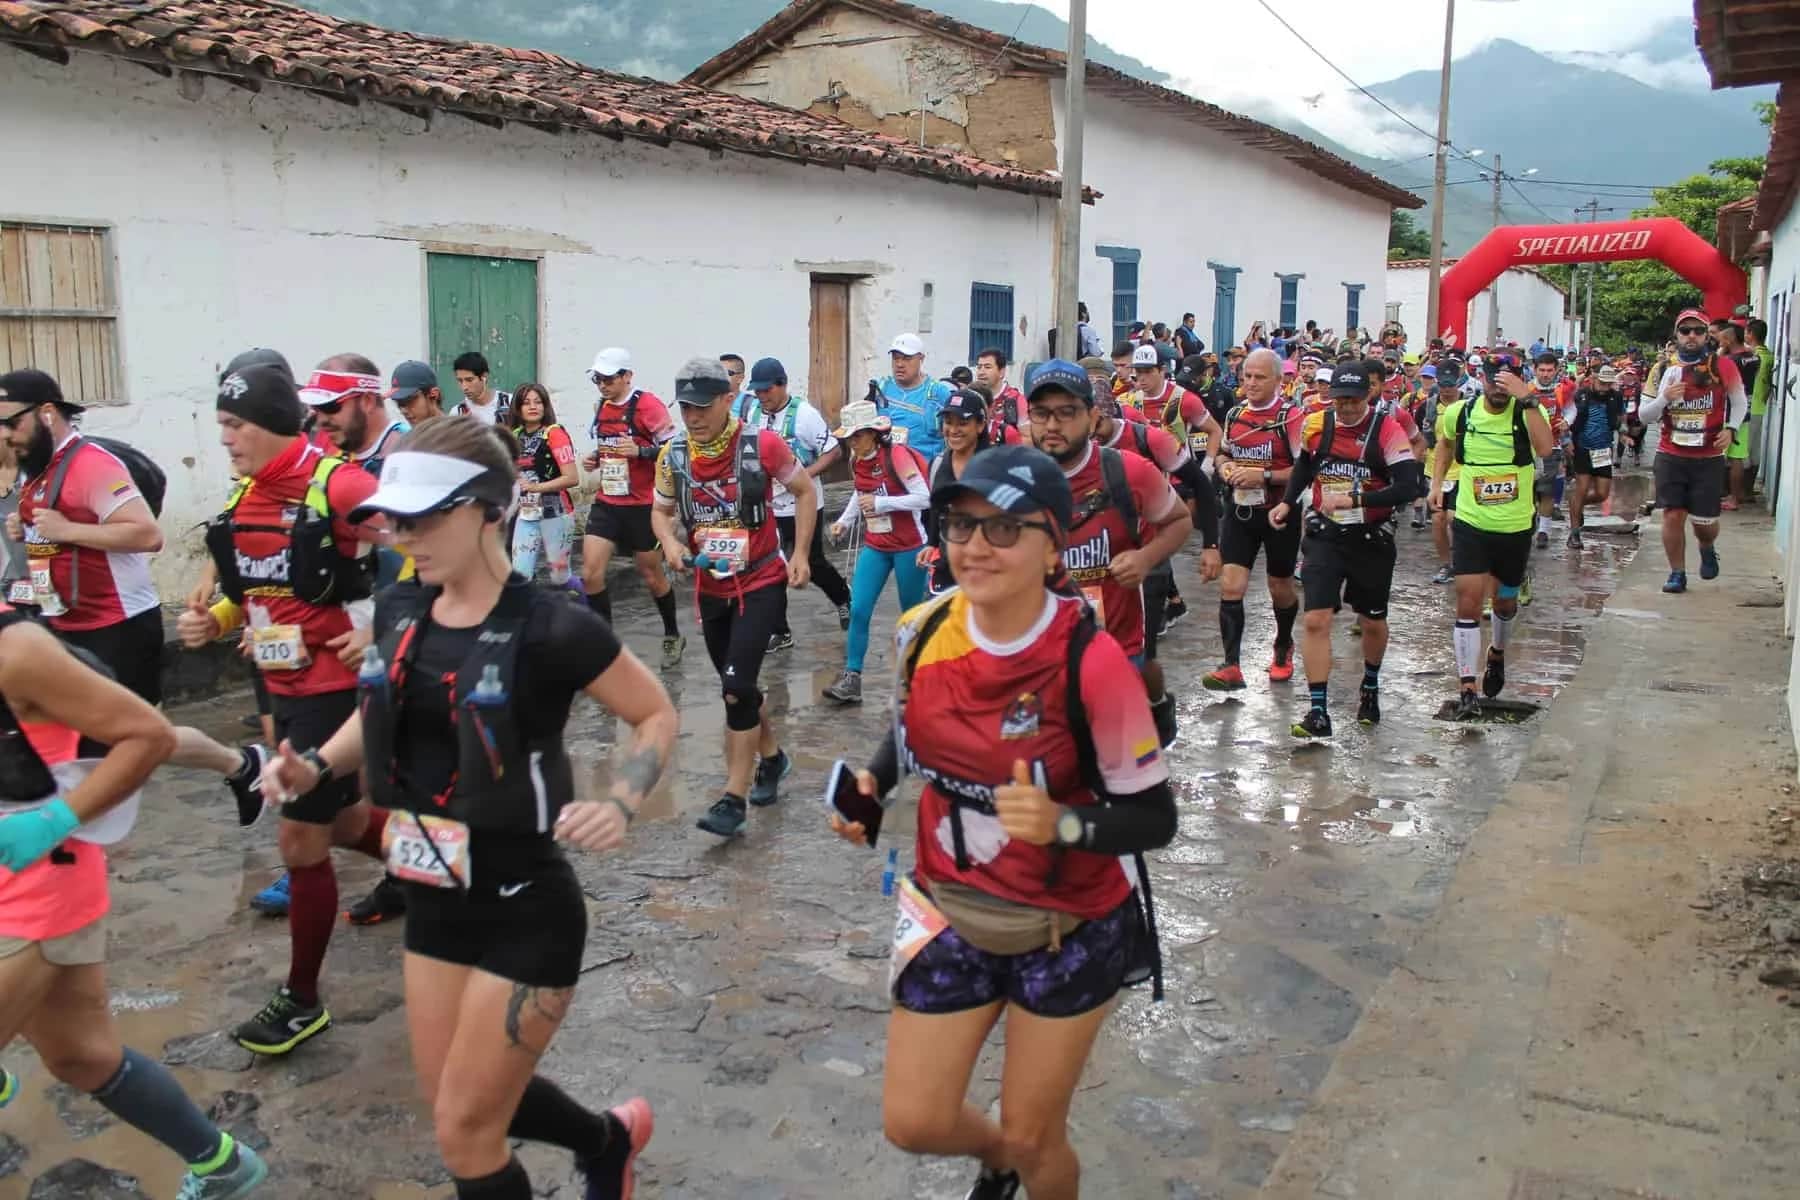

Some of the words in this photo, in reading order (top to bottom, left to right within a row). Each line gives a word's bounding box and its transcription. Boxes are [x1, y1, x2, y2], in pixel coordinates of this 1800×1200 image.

[1513, 230, 1652, 257] SPECIALIZED
[1484, 483, 1513, 494] 473
[709, 540, 738, 552] 599
[259, 643, 290, 660] 270
